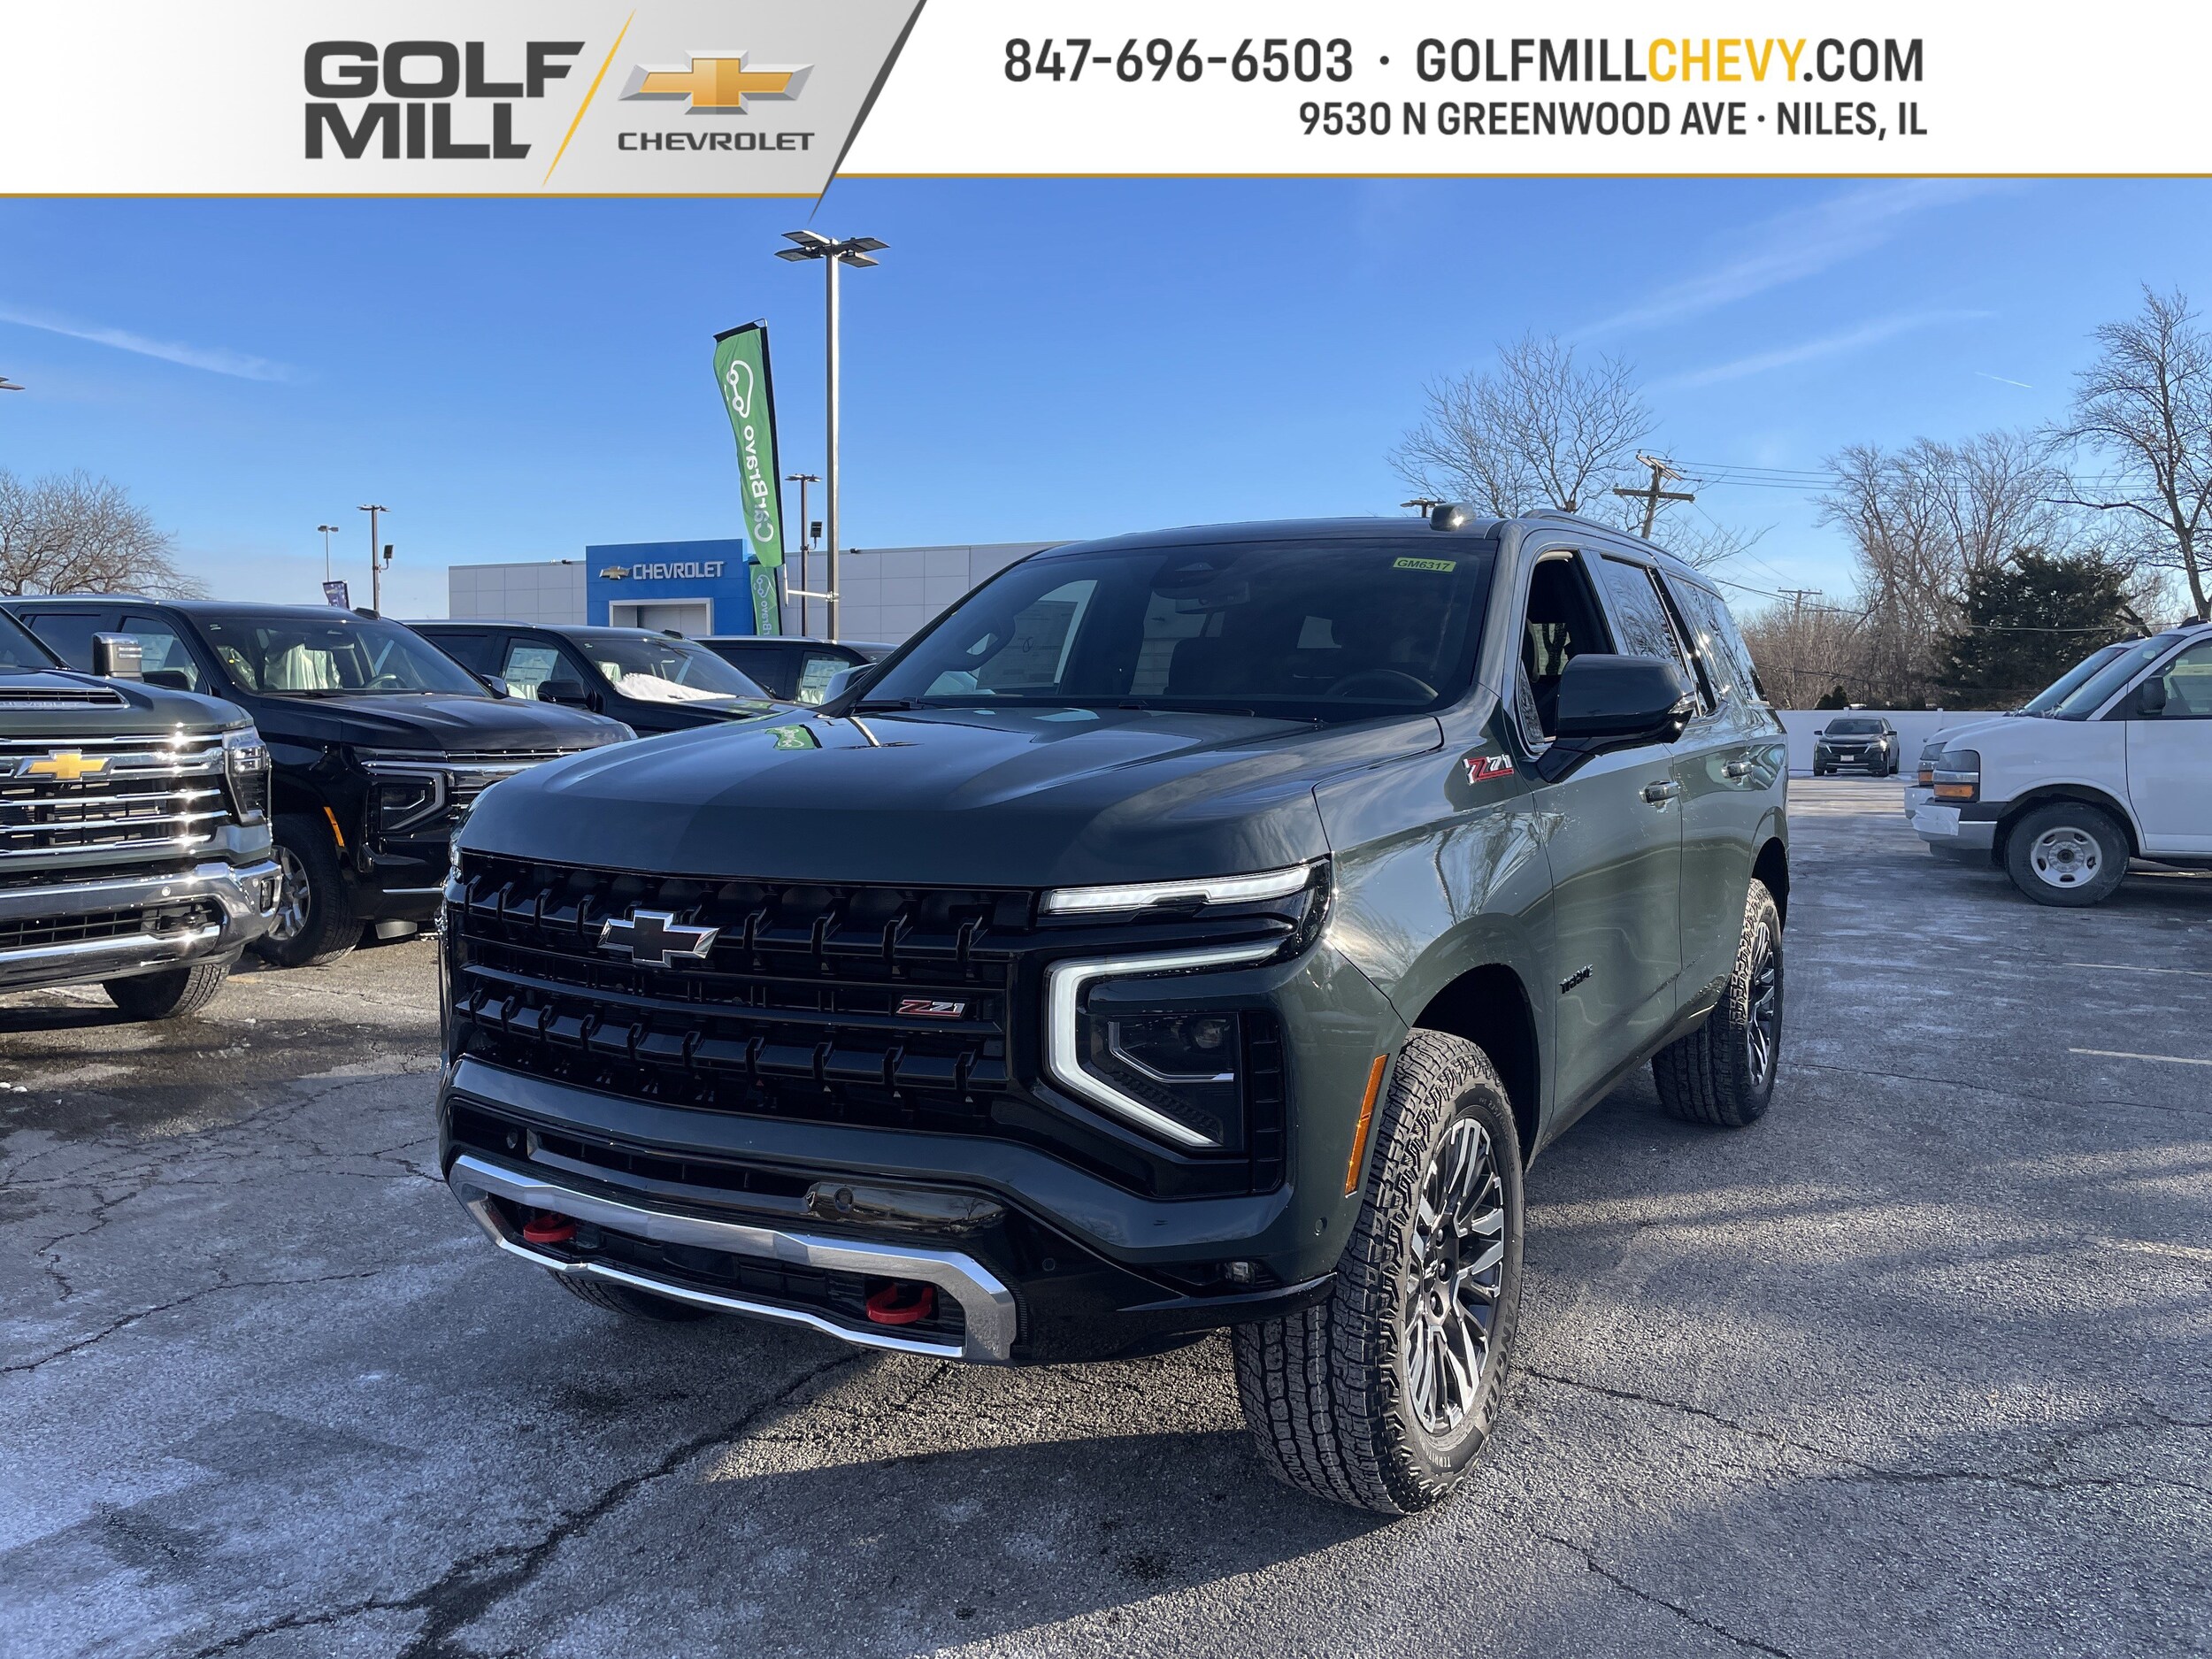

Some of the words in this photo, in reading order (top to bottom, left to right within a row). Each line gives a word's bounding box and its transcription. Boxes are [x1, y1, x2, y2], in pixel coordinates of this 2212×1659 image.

[633, 561, 725, 580] CHEVROLET
[1397, 559, 1450, 571] GM6317
[1462, 754, 1514, 785] Z71
[896, 999, 965, 1018] Z71
